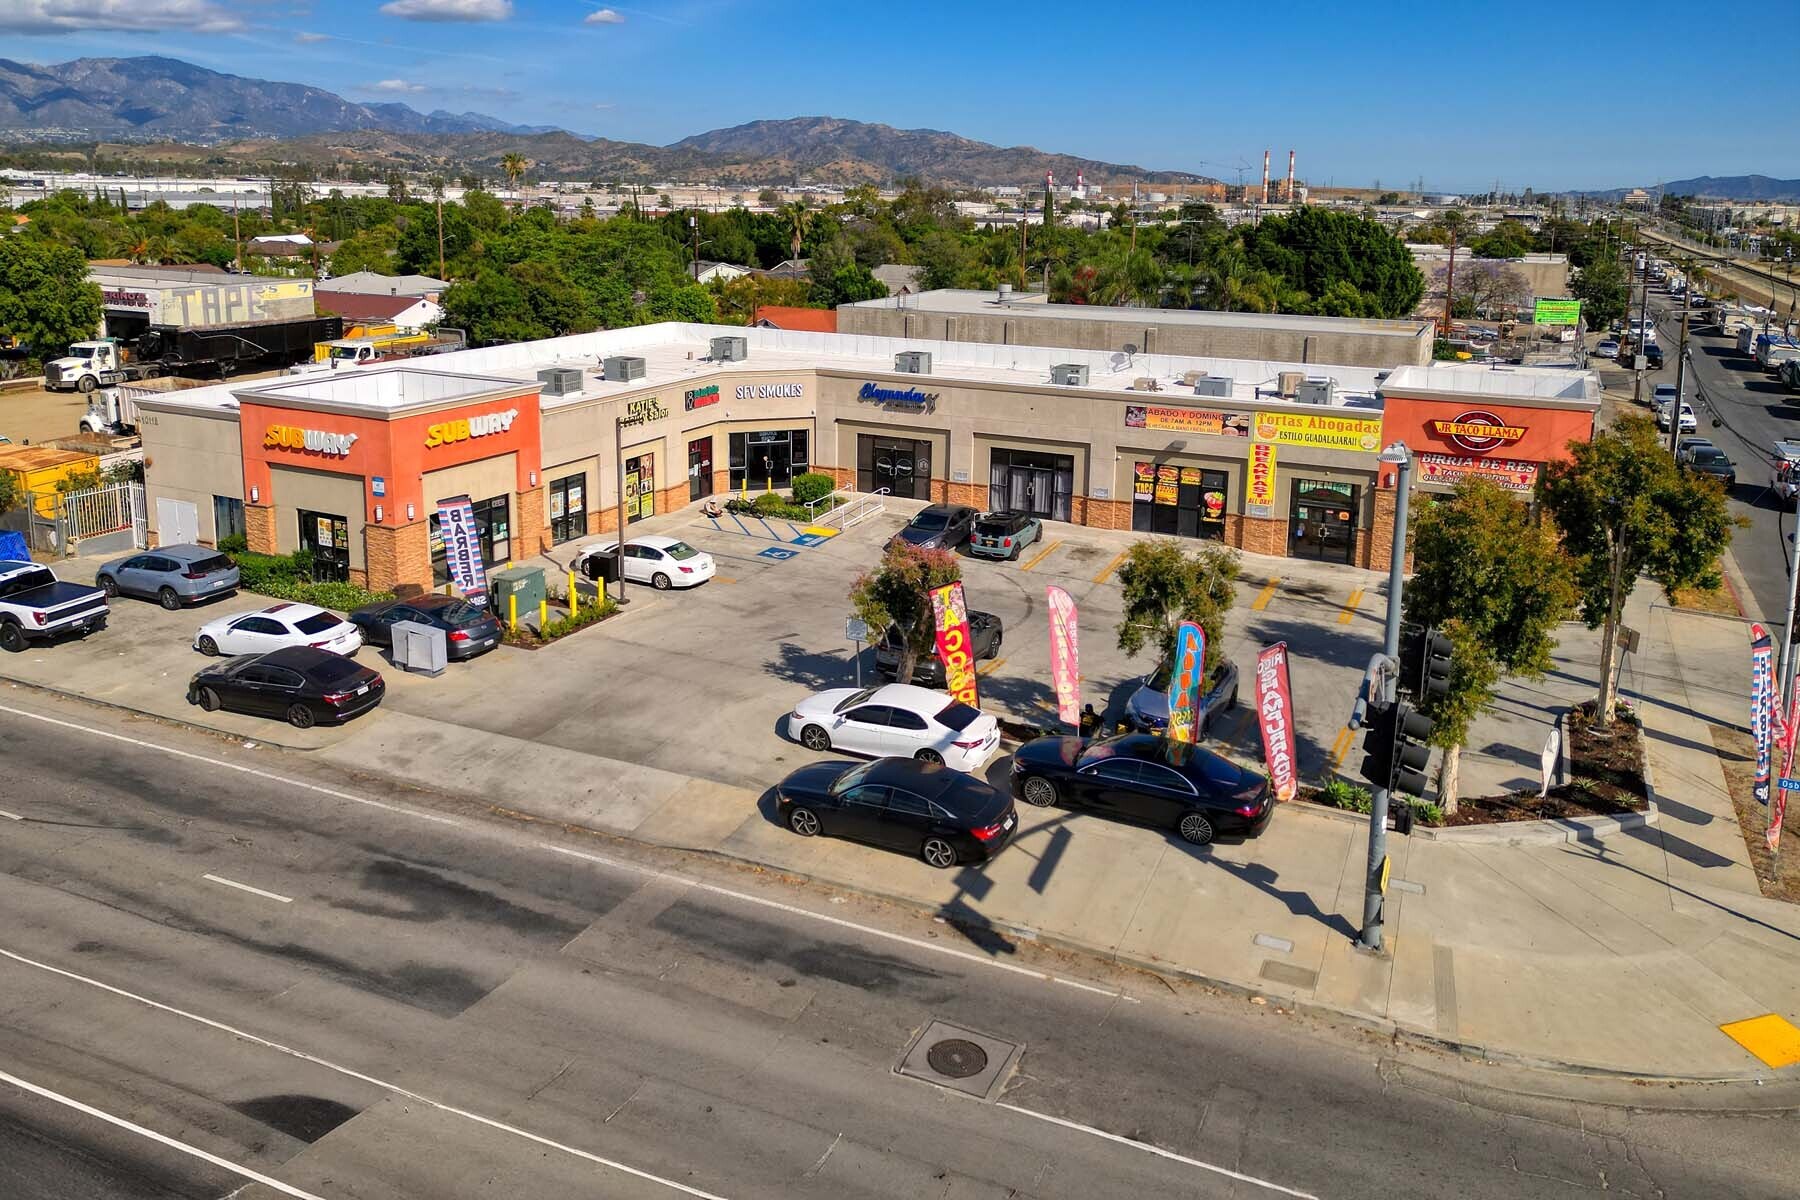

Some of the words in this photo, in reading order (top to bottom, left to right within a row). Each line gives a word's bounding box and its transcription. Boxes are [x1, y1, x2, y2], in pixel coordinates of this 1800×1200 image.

[103, 290, 148, 301] ERINO'S
[736, 385, 757, 400] SFV
[759, 383, 803, 399] SMOKES
[649, 407, 669, 421] Salon
[1147, 408, 1179, 418] ABADO
[1181, 410, 1188, 418] Y
[1189, 411, 1224, 421] DOMING
[425, 408, 519, 449] SUBWAY
[1257, 413, 1303, 427] Tortas
[1308, 416, 1380, 433] Ahogadas
[1439, 422, 1451, 433] JR
[1455, 424, 1480, 435] TACO
[1483, 426, 1519, 439] LLAMA
[264, 424, 359, 456] SUBWAY
[1279, 430, 1303, 441] ESTILO
[85, 460, 94, 468] 23
[1421, 453, 1474, 467] BIRRIA
[1480, 458, 1501, 470] DE
[1504, 461, 1537, 473] RES
[1252, 444, 1271, 498] BREAKFAST
[1135, 482, 1154, 494] TACO
[1300, 479, 1333, 494] OPEN
[1782, 779, 1800, 790] Osb
